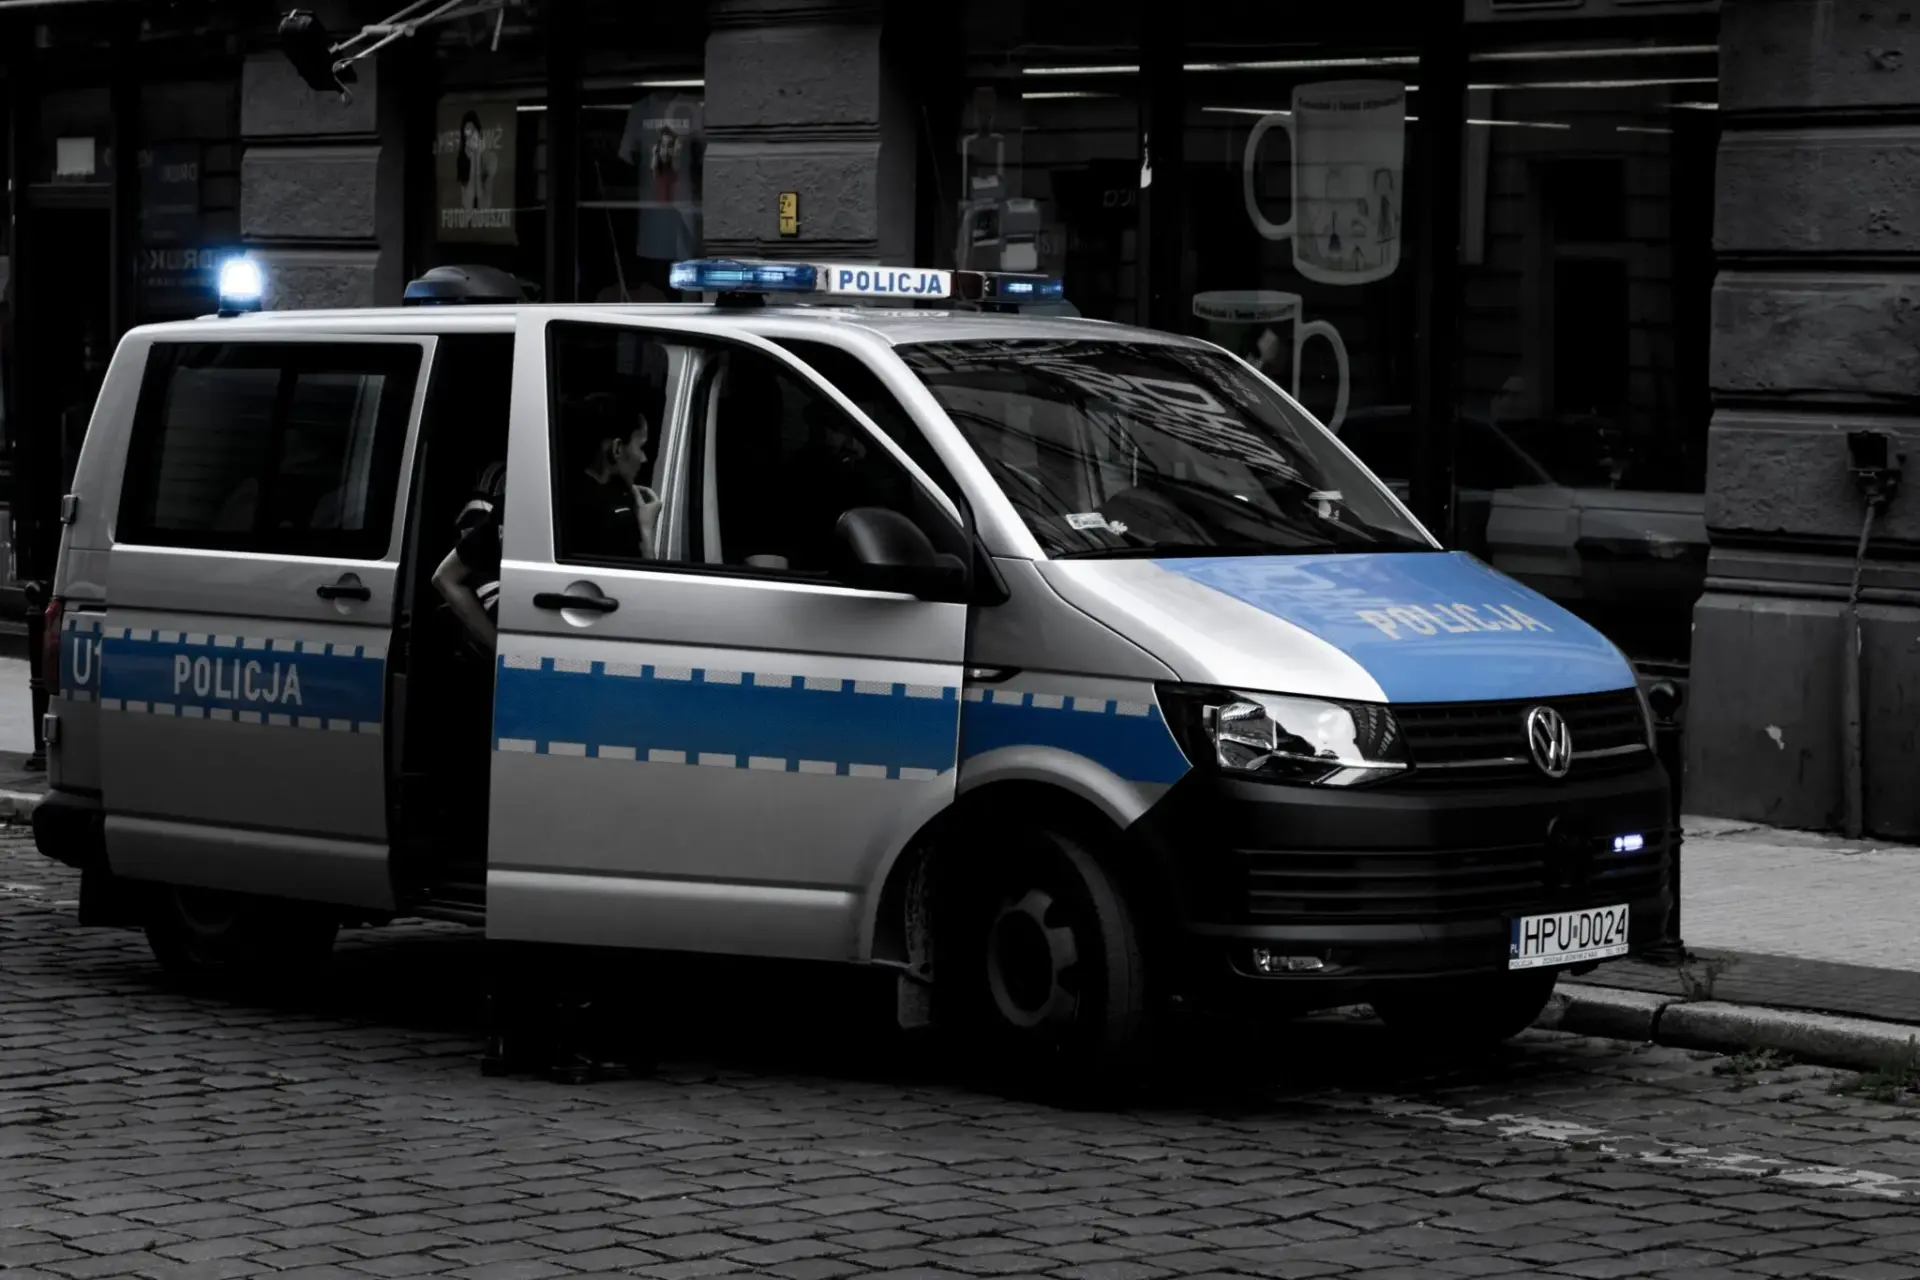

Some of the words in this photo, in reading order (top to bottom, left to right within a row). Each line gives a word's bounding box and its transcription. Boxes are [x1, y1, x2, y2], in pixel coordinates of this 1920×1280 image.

[839, 269, 942, 294] POLICJA
[1354, 603, 1554, 640] POLICJA
[174, 654, 302, 705] POLICJA
